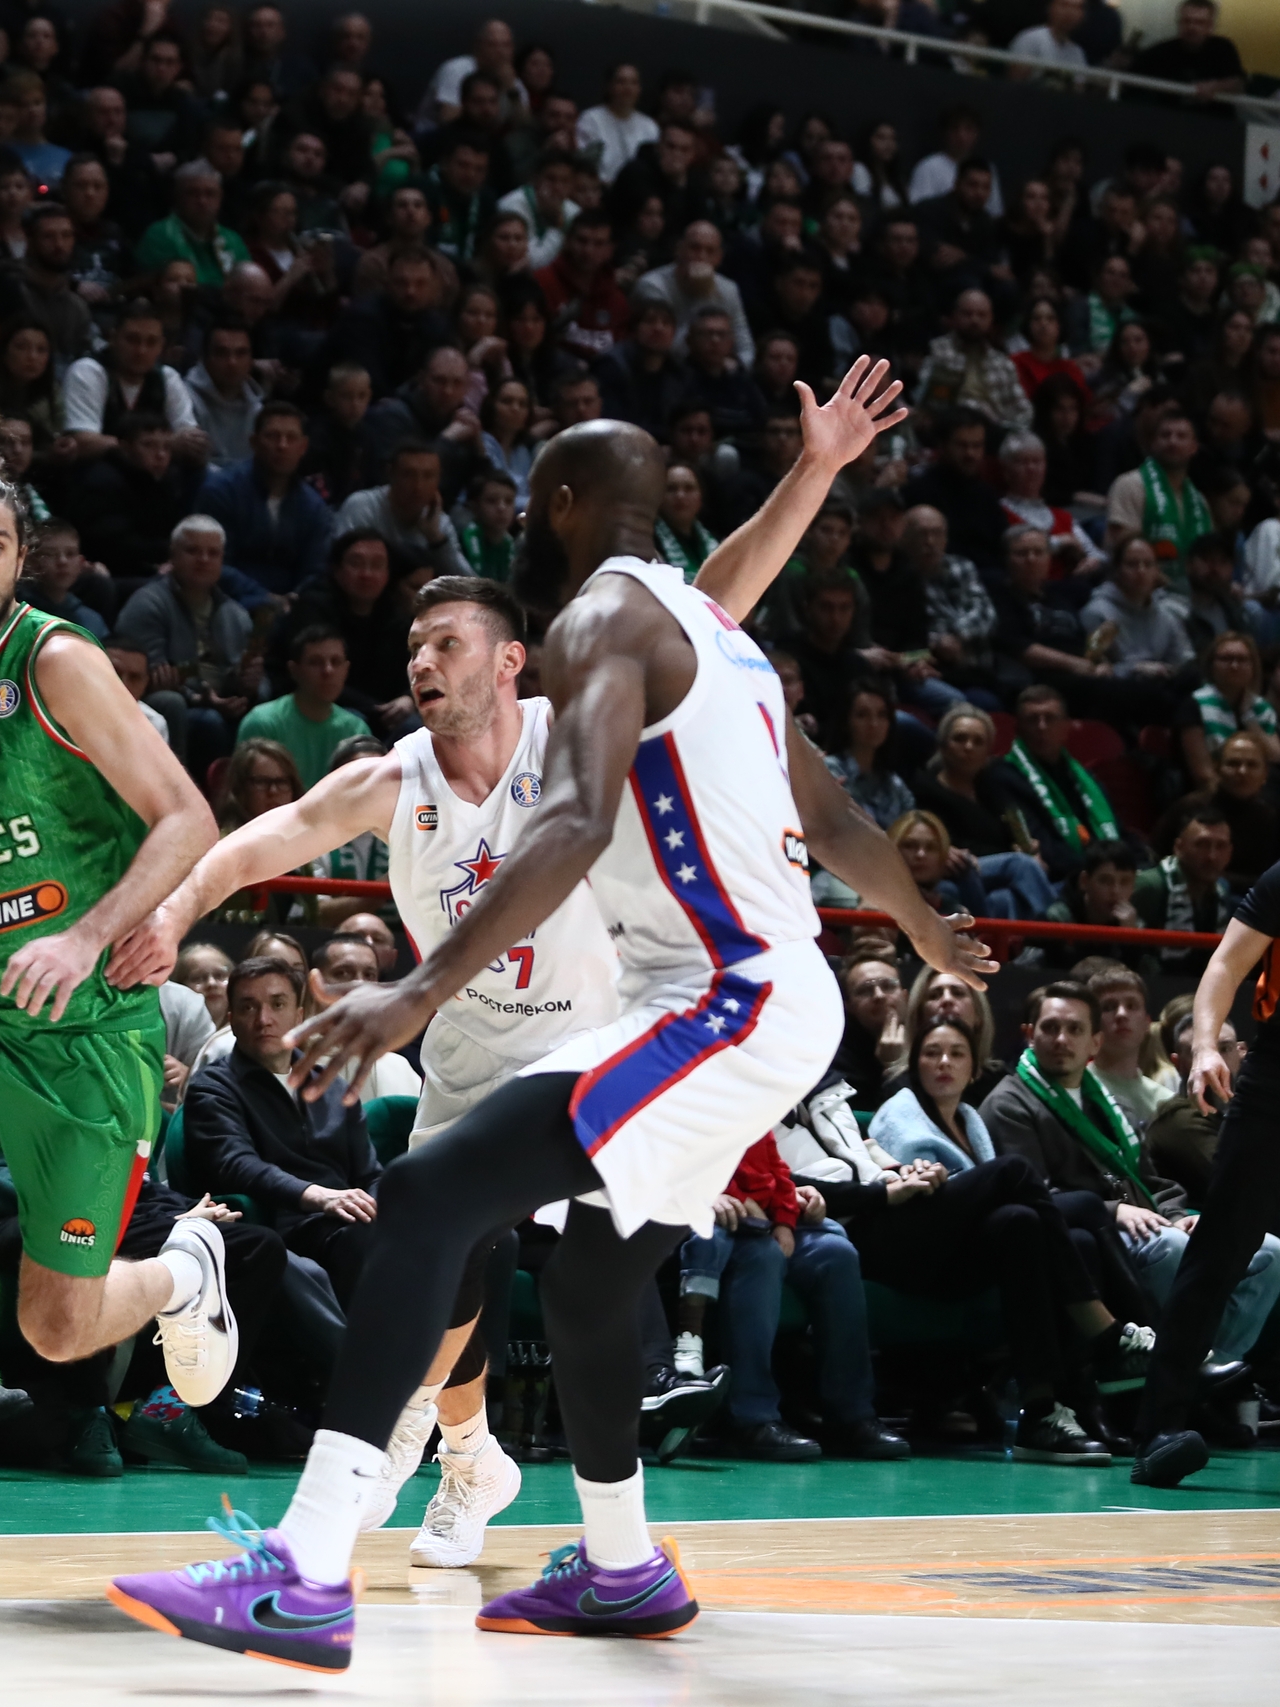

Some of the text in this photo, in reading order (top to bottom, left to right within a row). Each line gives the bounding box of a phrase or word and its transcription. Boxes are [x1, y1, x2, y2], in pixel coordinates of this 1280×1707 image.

[507, 945, 535, 990] 7
[465, 987, 572, 1017] Ростелеком
[60, 1229, 96, 1246] UNICS
